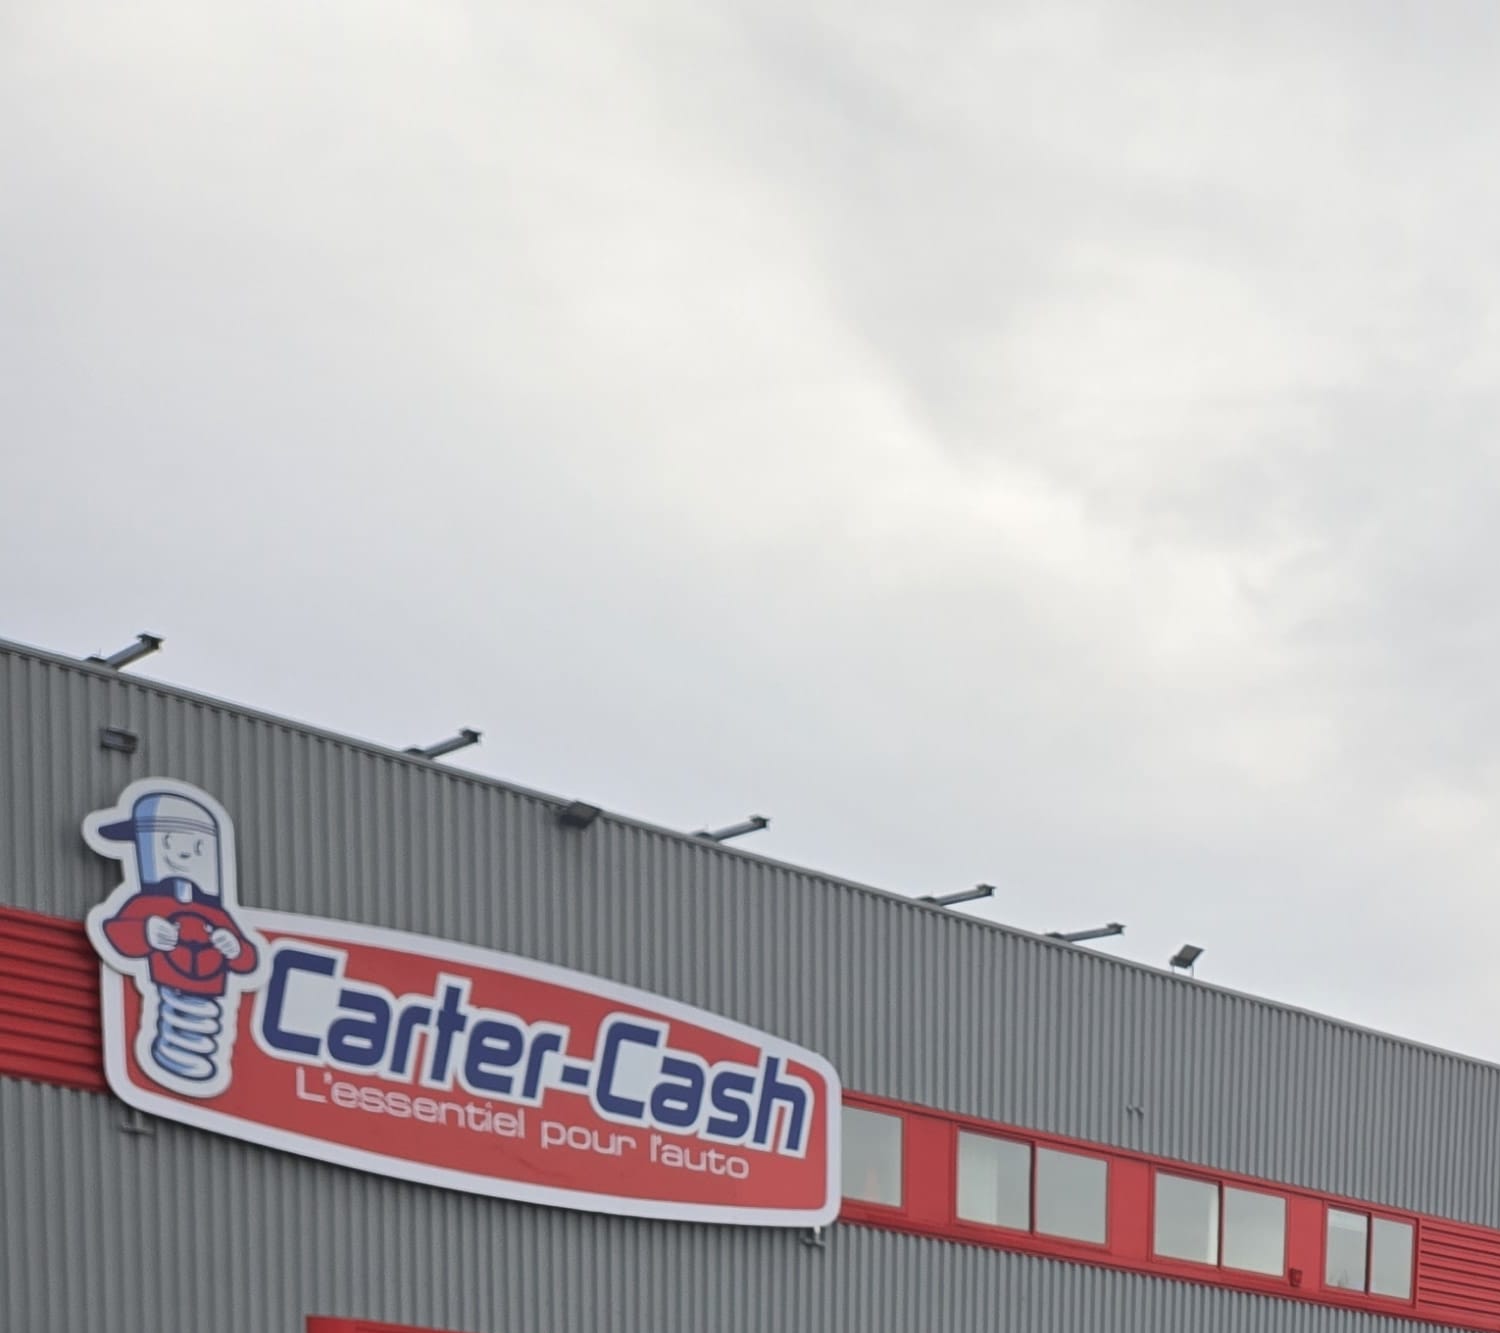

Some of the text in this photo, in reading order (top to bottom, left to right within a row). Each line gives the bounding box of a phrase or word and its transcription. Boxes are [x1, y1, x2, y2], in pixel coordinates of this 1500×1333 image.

[262, 948, 808, 1152] Carter-Cash
[295, 1068, 750, 1179] L'essentiel pour l'auto
